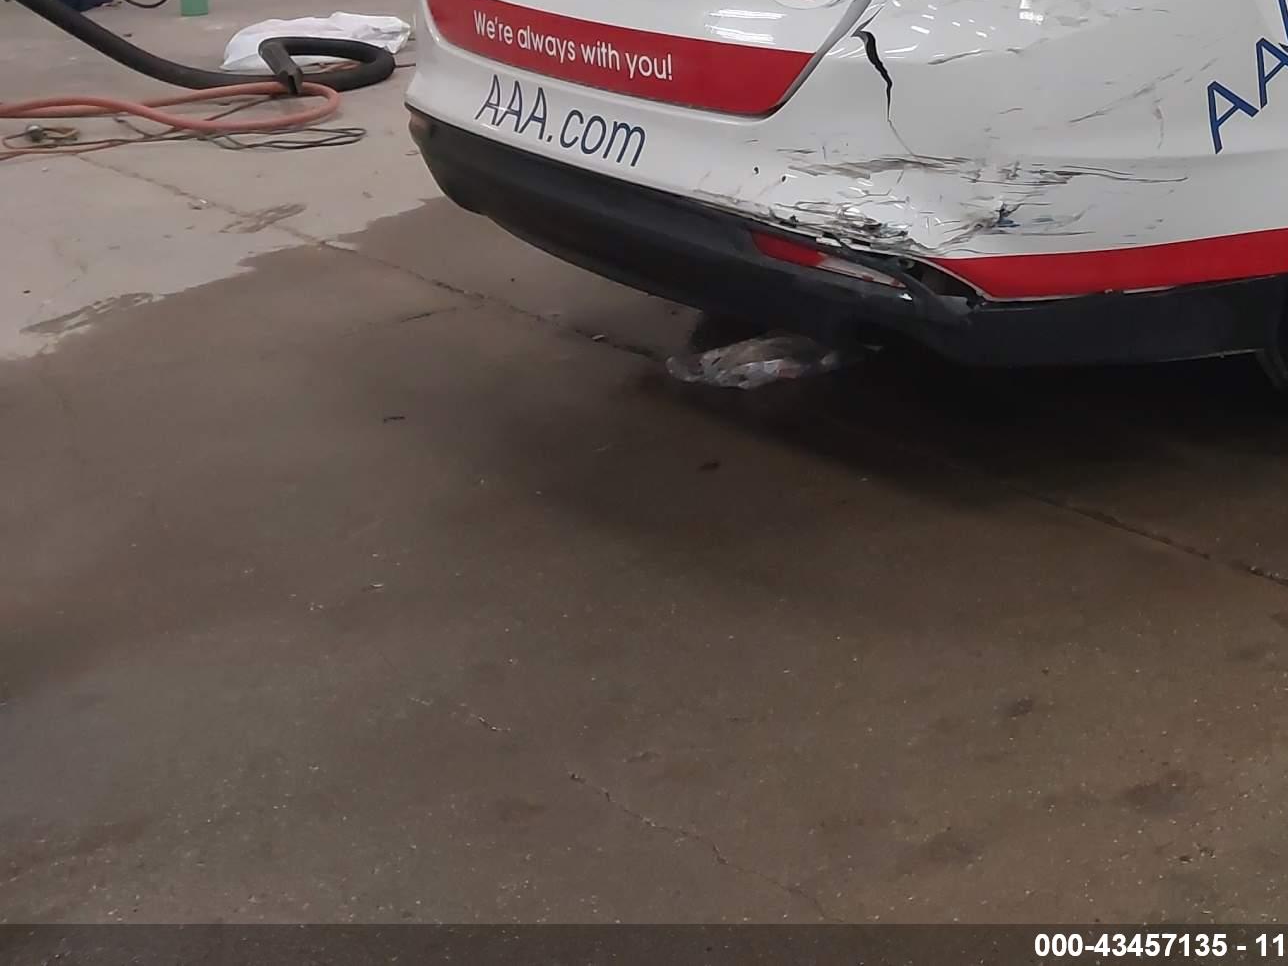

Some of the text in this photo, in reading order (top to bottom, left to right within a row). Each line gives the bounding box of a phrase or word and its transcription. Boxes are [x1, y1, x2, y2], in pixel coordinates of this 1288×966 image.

[473, 10, 673, 81] We're always with you!
[474, 73, 646, 167] AAA.com
